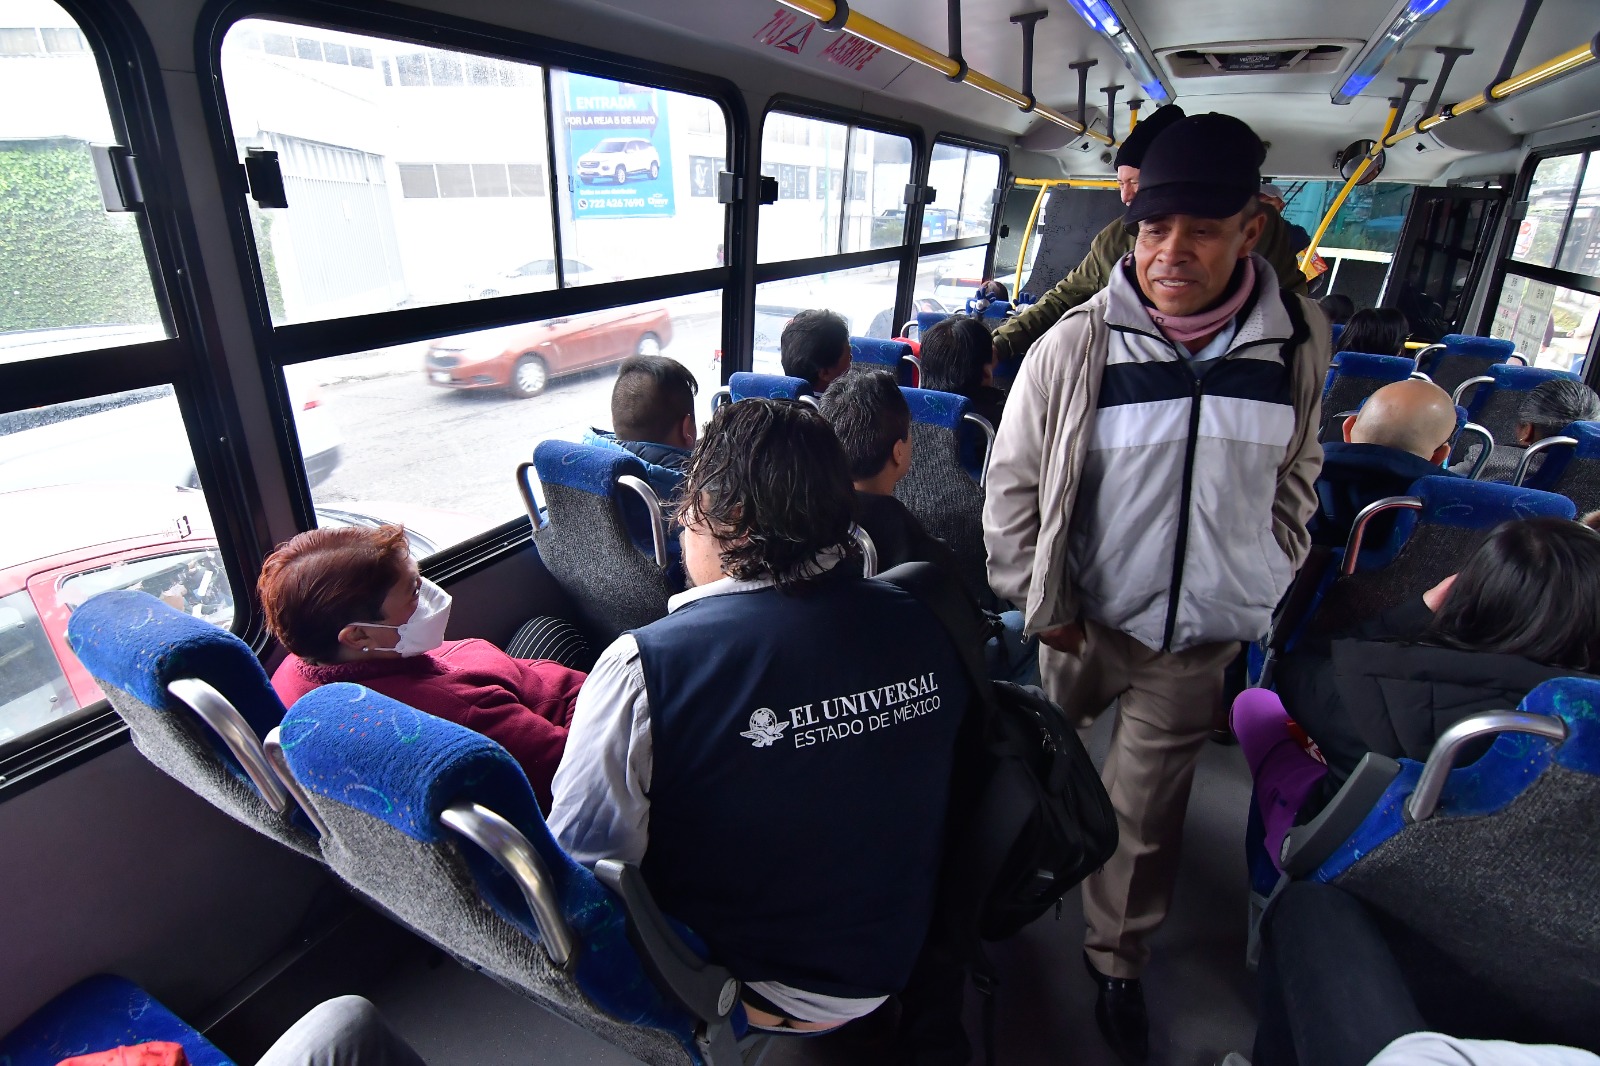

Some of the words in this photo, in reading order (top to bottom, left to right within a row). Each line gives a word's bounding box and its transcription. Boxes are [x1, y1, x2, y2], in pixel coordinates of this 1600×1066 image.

[752, 8, 797, 45] 713
[575, 96, 637, 110] ENTRADA
[565, 116, 582, 125] POR
[583, 116, 593, 125] LA
[594, 116, 613, 125] REJA
[621, 116, 632, 125] DE
[632, 116, 655, 125] MAYO
[588, 199, 605, 208] 722
[788, 703, 819, 729] EL
[821, 672, 939, 720] UNIVERSAL
[794, 719, 864, 749] ESTADO
[868, 712, 891, 732] DE
[893, 695, 941, 725] MÉXICO
